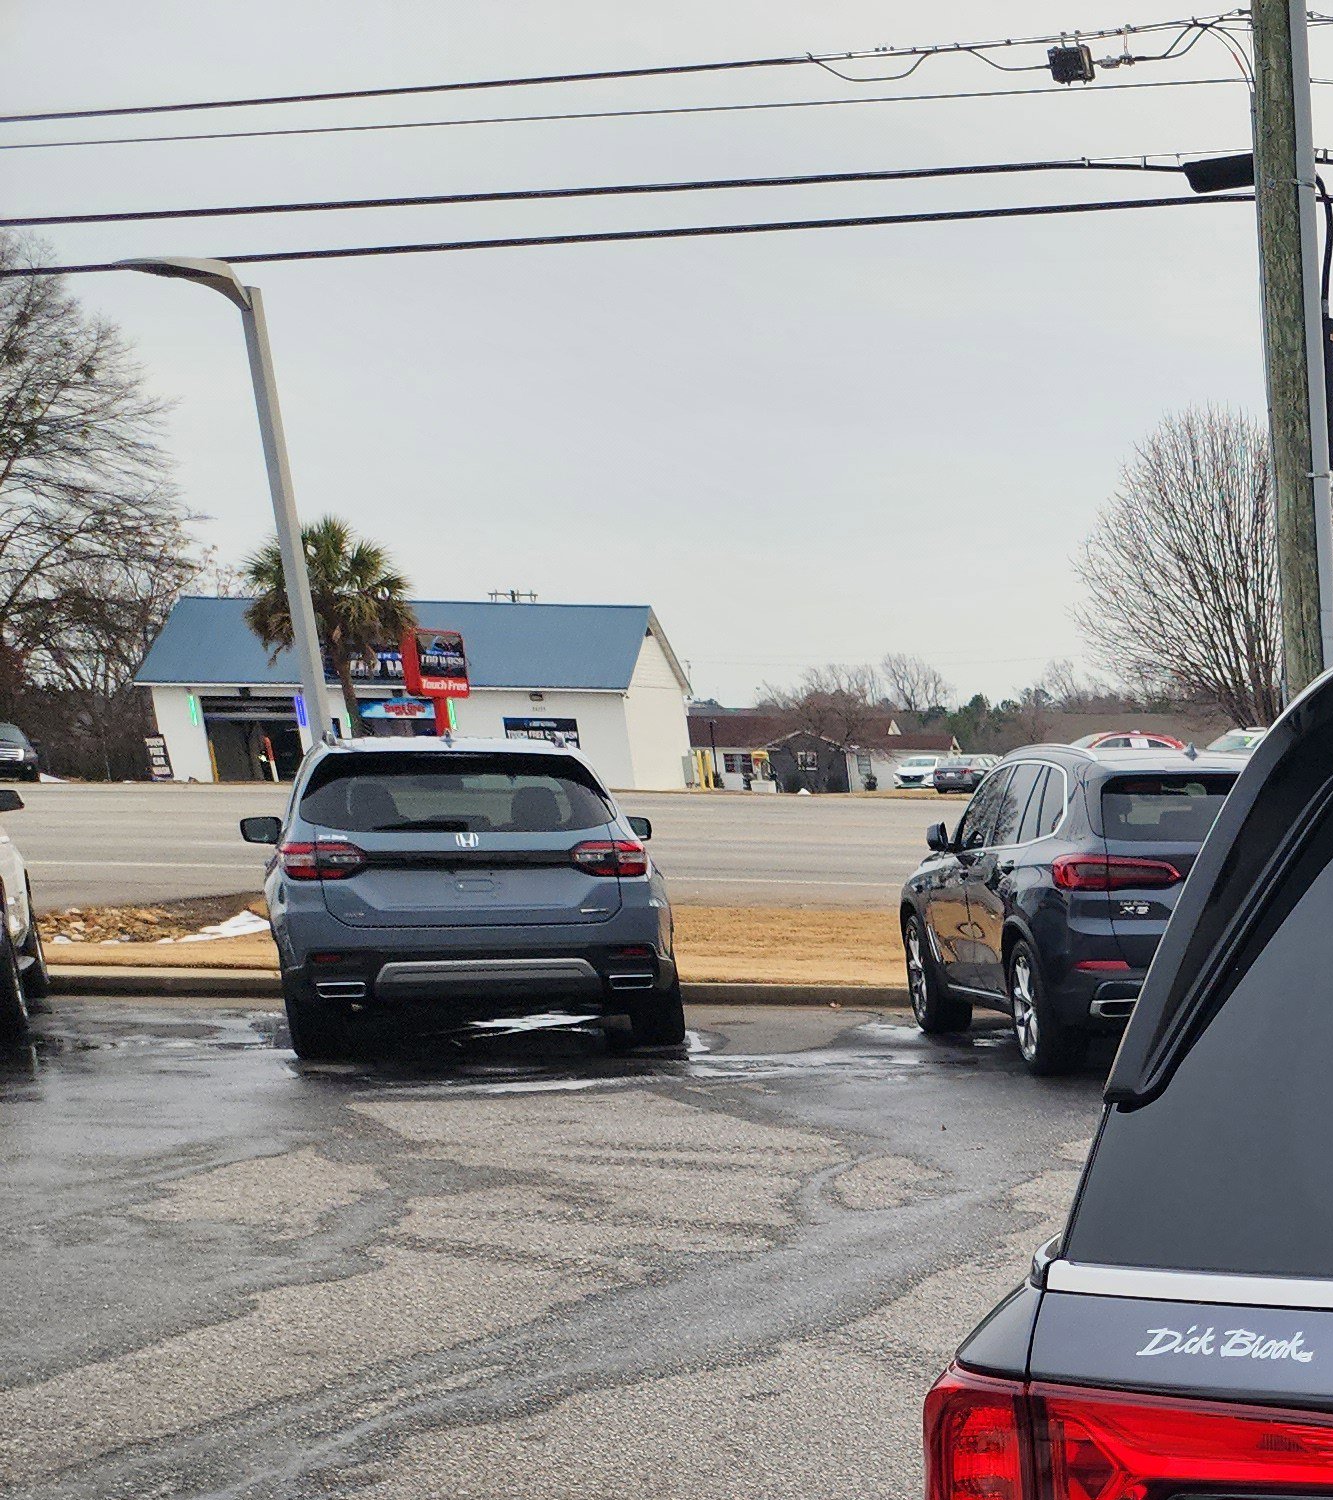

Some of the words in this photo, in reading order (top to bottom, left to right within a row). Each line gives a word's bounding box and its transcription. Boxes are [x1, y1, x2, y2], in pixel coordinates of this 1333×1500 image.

[422, 678, 447, 690] Touch
[448, 680, 468, 691] Free
[1136, 1324, 1215, 1356] Dick
